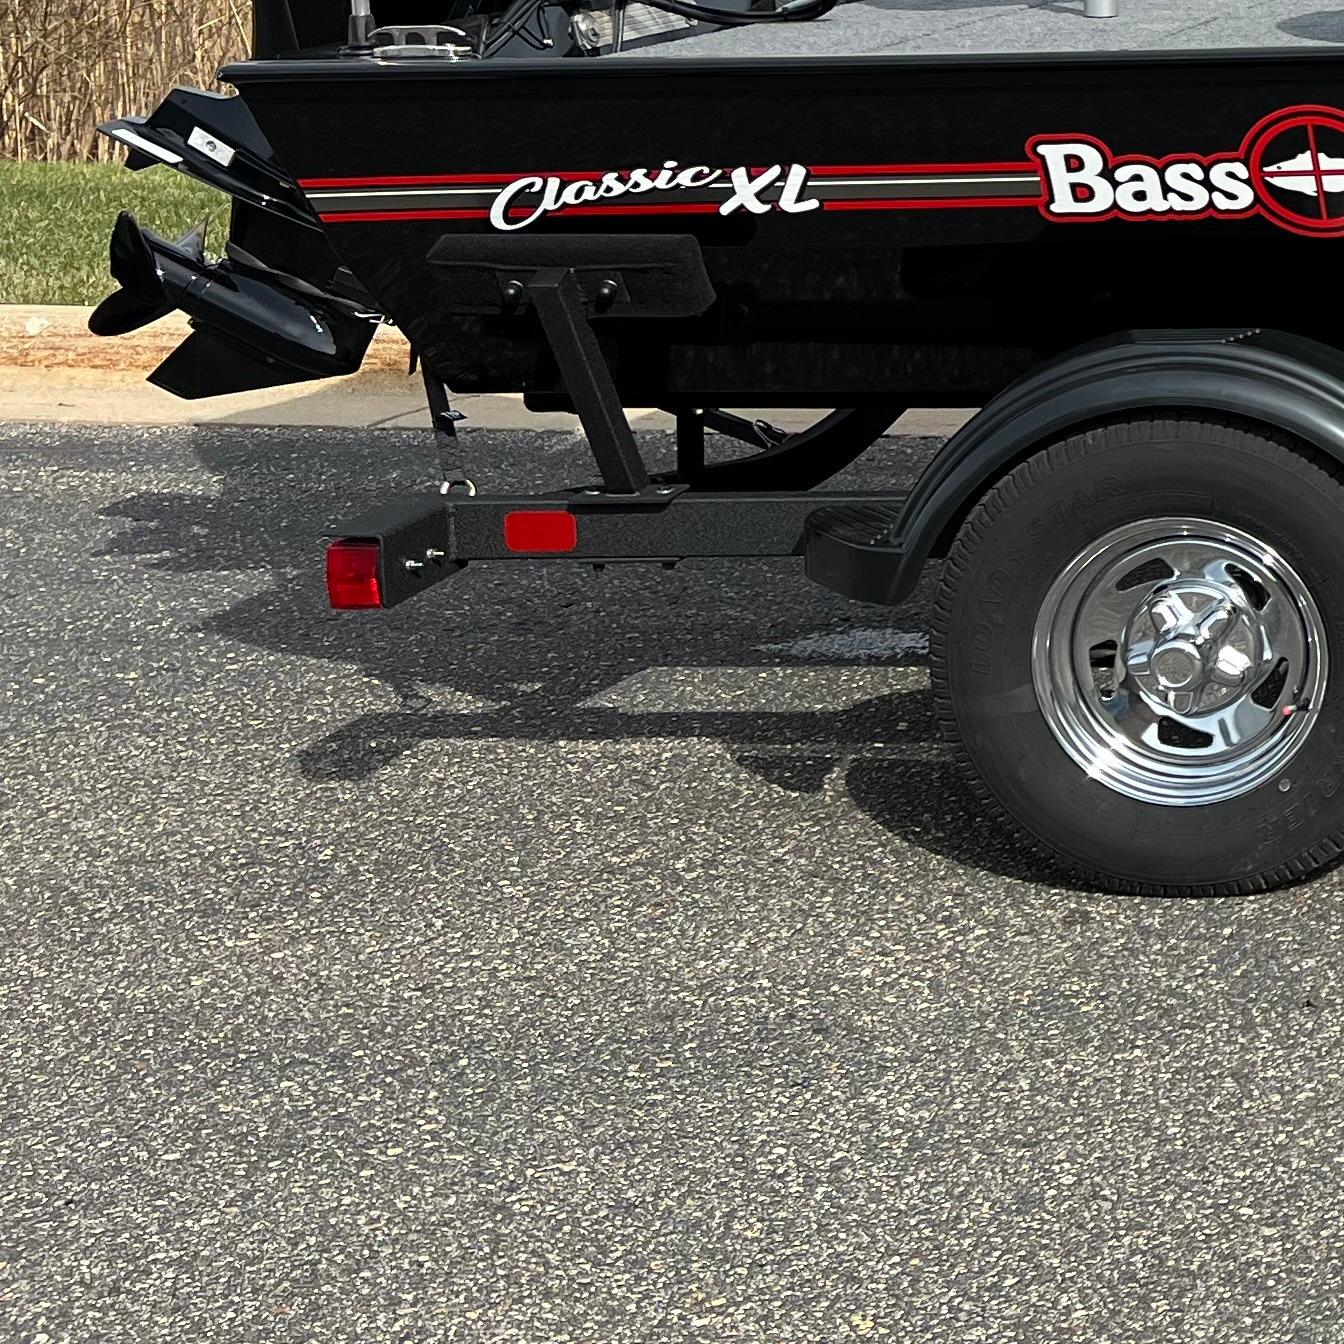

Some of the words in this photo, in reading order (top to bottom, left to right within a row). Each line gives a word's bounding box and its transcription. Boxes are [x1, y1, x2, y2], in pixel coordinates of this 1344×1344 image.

[489, 160, 723, 231] Classic
[719, 163, 820, 216] XL
[1036, 143, 1255, 214] Bass
